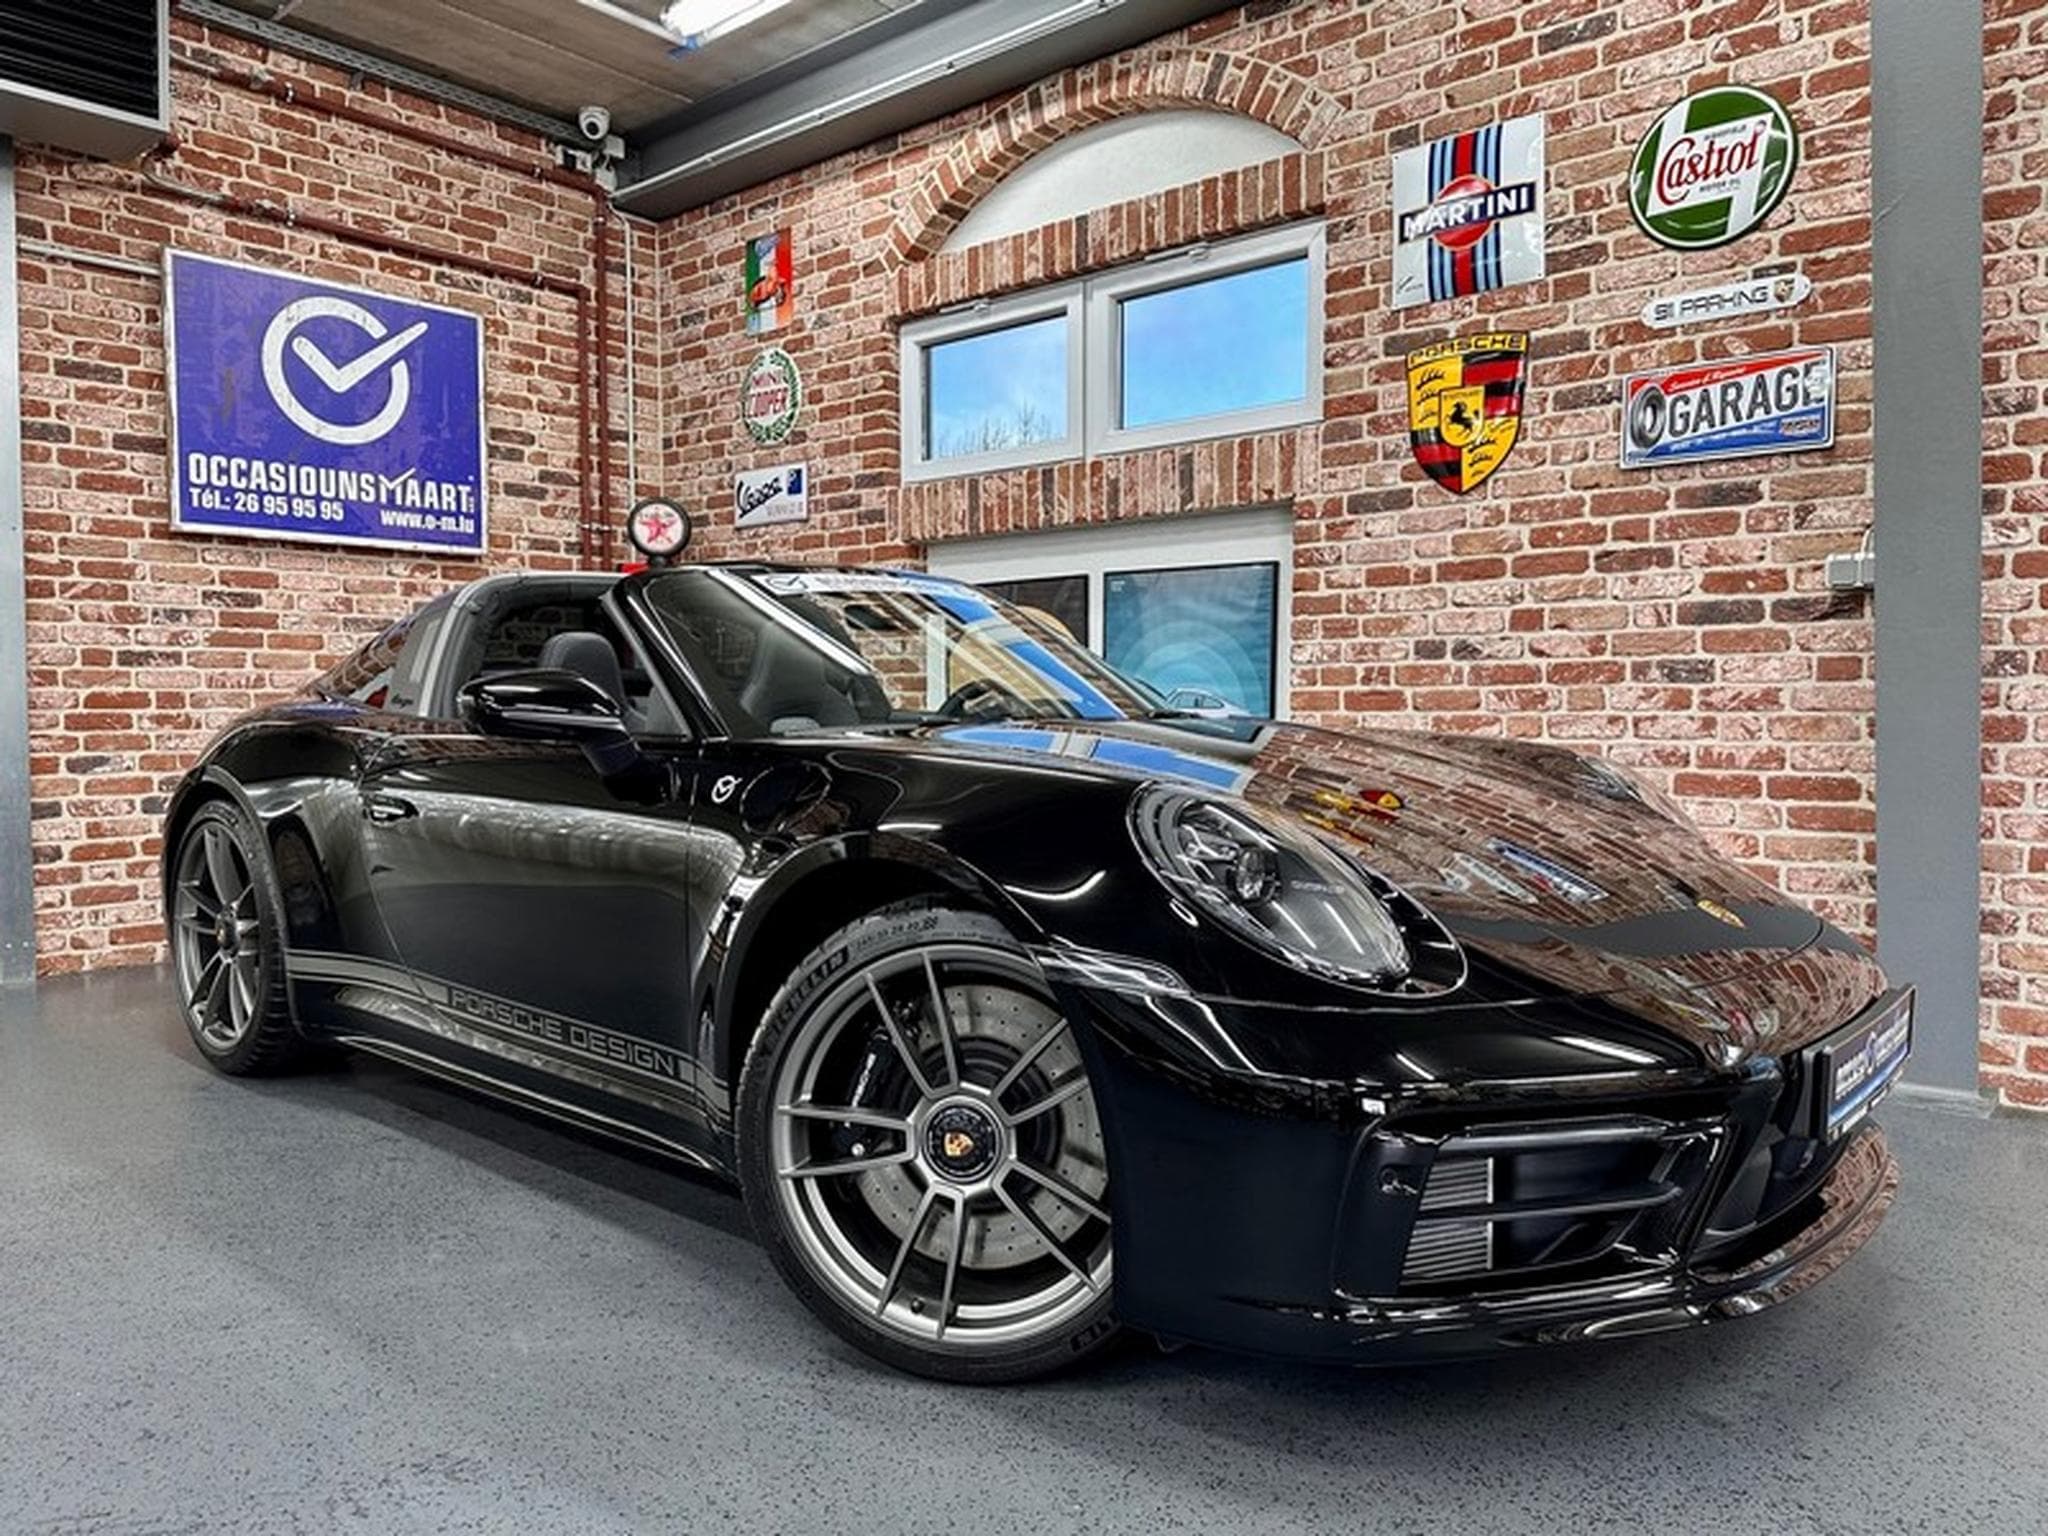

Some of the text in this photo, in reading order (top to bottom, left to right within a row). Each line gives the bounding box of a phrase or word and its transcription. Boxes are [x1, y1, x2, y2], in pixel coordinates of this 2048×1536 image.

[1657, 119, 1767, 206] Castrol
[1403, 187, 1529, 239] MARTINI
[1679, 286, 1768, 316] PARKING
[1410, 335, 1522, 364] PORSCHE
[1668, 360, 1826, 438] GARAGE
[188, 452, 471, 513] OCCASIOUNSMAART
[234, 491, 260, 513] 26
[263, 494, 288, 516] 95
[291, 497, 317, 519] 95
[320, 500, 344, 521] 95
[452, 988, 674, 1077] PORSCHE DESIGN
